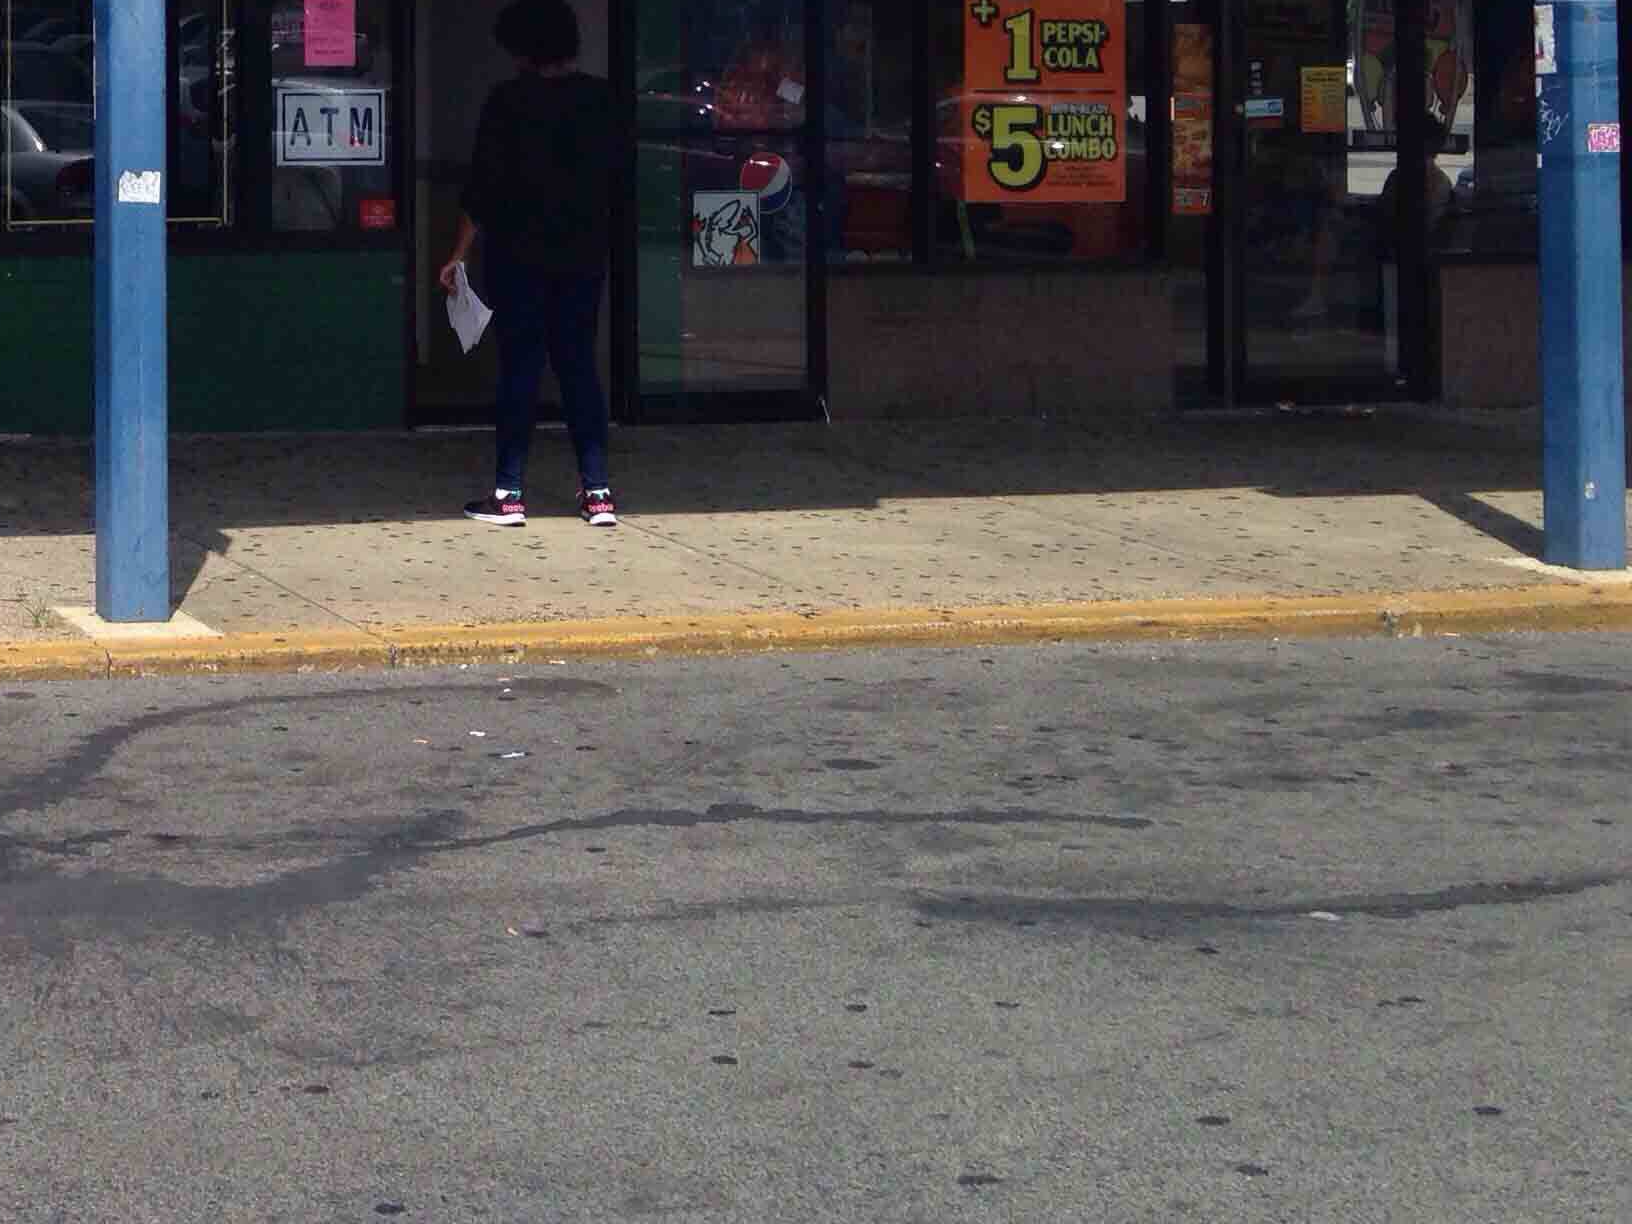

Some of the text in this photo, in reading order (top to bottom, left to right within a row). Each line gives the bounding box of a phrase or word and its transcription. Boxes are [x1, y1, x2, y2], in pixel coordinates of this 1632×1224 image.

[1004, 8, 1041, 82] 1
[1041, 44, 1102, 71] COLA
[289, 106, 374, 147] ATM
[1045, 114, 1115, 137] LUNCH
[1044, 136, 1117, 160] COMBO
